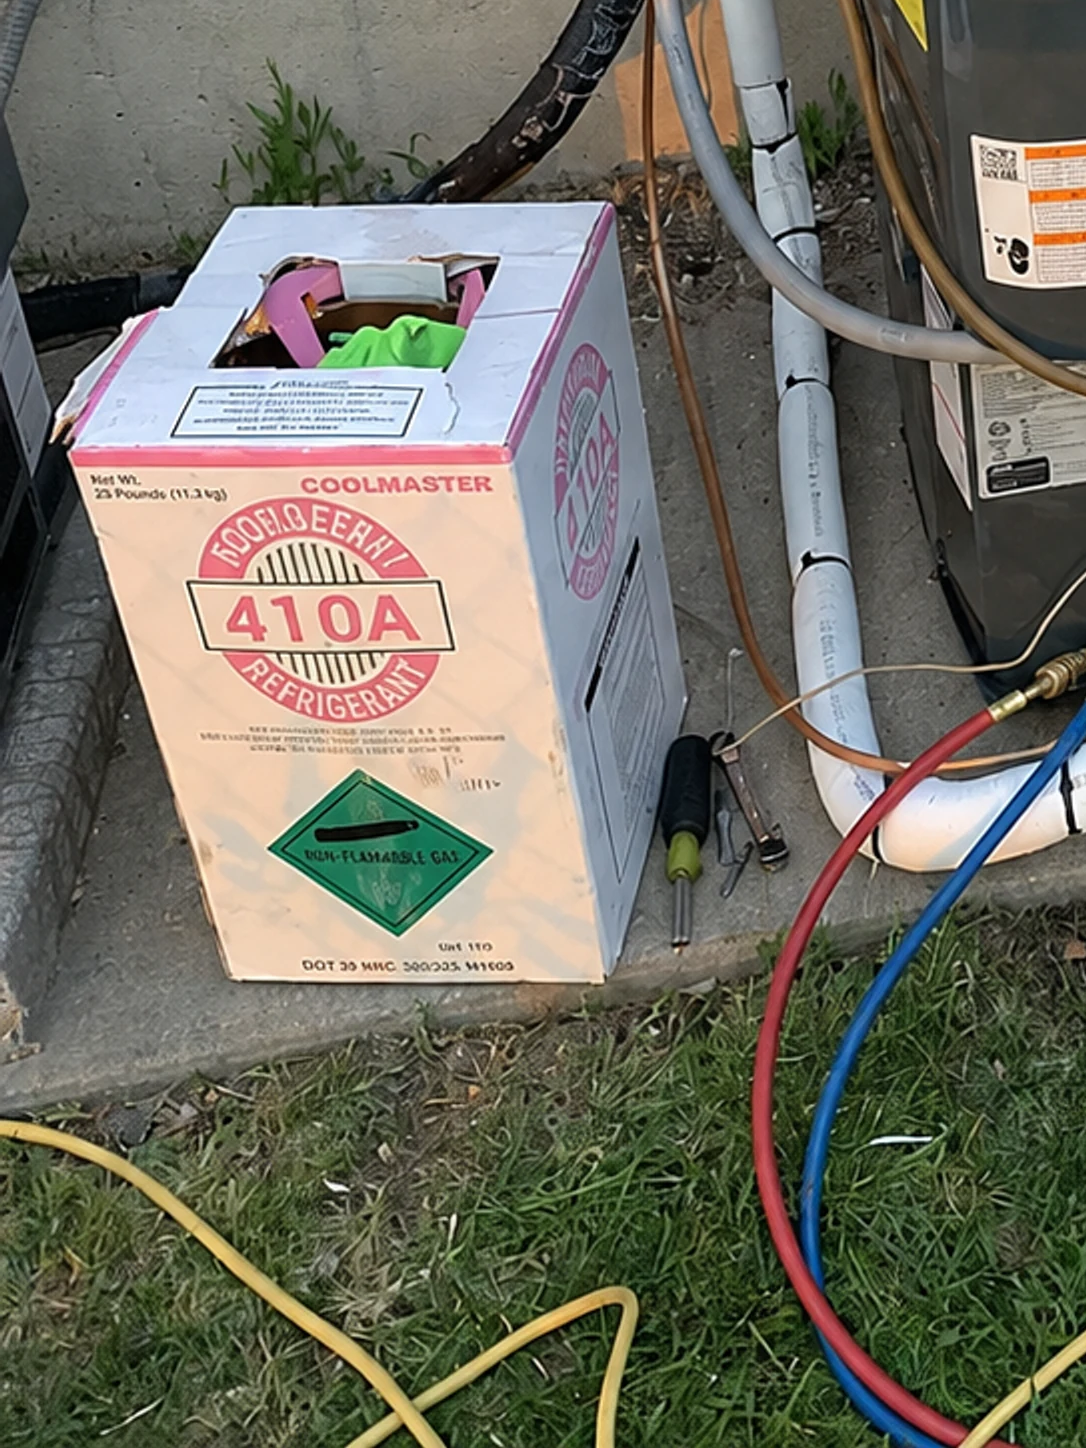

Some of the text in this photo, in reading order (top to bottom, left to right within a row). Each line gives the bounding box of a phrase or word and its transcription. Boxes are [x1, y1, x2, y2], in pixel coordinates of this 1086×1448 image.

[300, 476, 493, 494] COOLMASTER
[226, 594, 421, 643] 410A
[241, 657, 426, 720] REFRIGERANT
